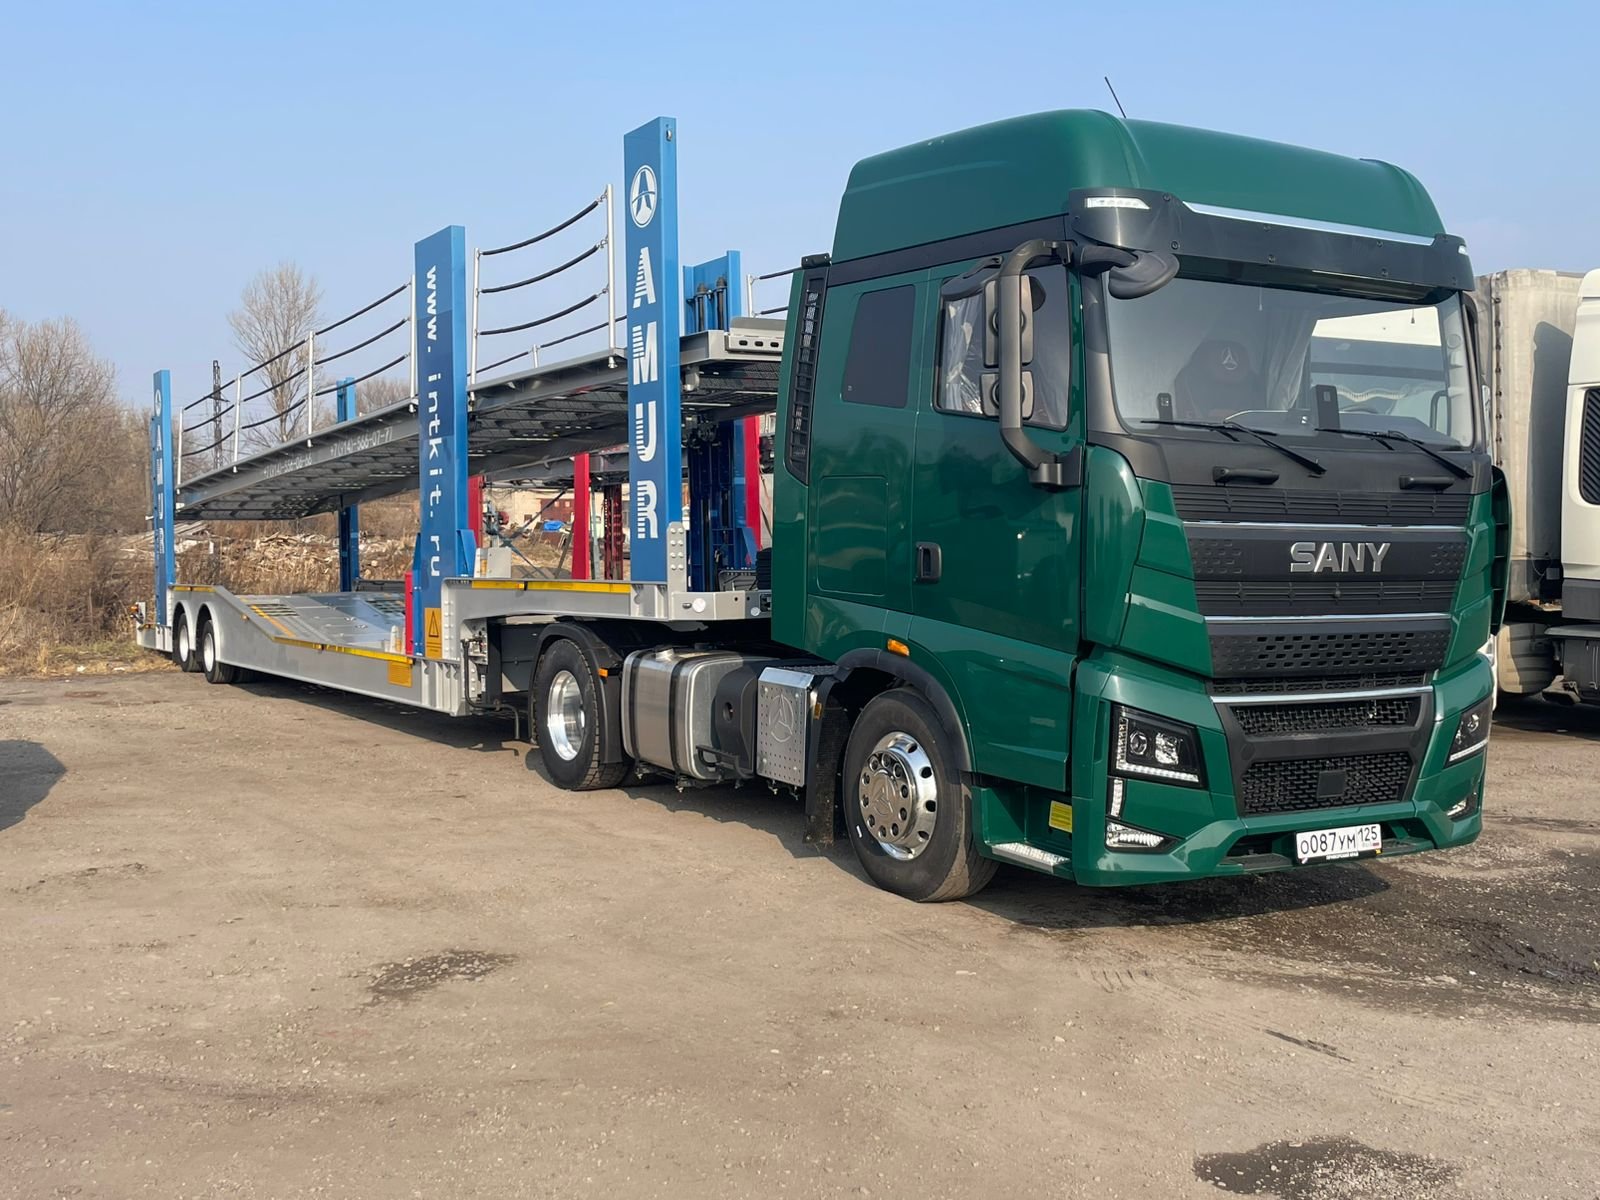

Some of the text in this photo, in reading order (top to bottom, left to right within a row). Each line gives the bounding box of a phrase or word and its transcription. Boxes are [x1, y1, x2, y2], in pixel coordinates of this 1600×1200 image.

[632, 246, 660, 539] AMUR
[1290, 541, 1391, 573] SANY
[1357, 825, 1378, 842] 125
